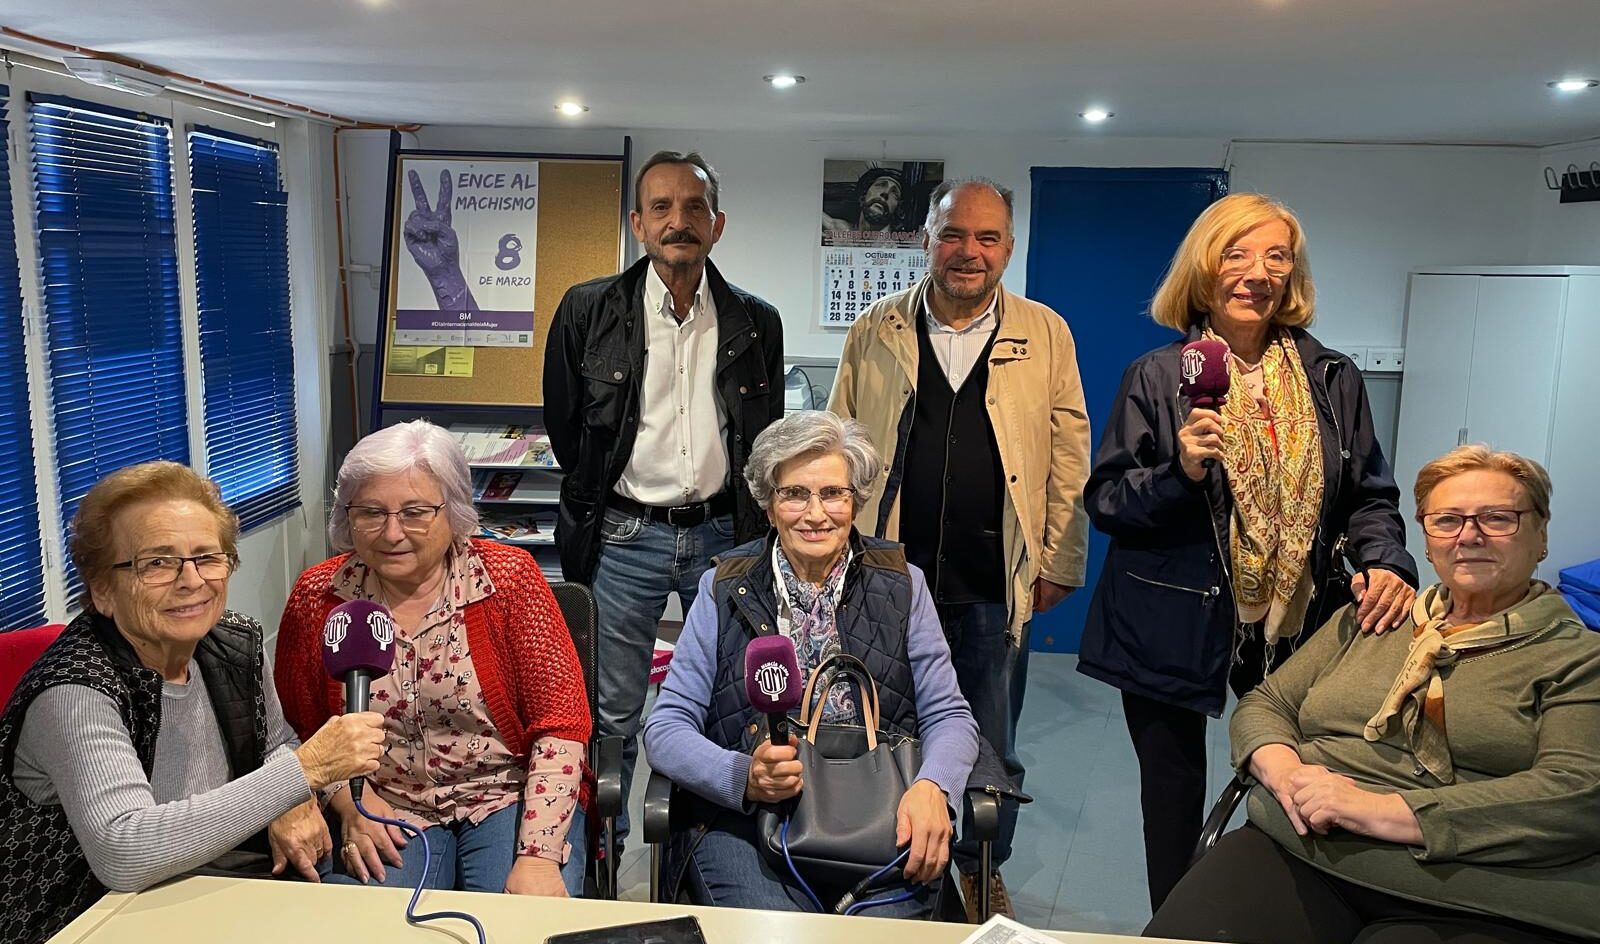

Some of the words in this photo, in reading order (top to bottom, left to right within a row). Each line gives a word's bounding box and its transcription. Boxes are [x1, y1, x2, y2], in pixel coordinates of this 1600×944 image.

[458, 173, 506, 188] ENCE
[510, 174, 536, 191] AL
[456, 196, 535, 211] MACHISMO
[494, 234, 522, 270] 8
[850, 270, 854, 278] 1
[864, 270, 870, 278] 2
[880, 271, 885, 279] 3
[894, 271, 900, 279] 4
[909, 272, 915, 280] 5
[480, 276, 492, 286] DE
[496, 276, 531, 287] MARZO
[834, 280, 839, 288] 7
[848, 280, 854, 289] 8
[864, 281, 870, 289] 9
[877, 282, 887, 290] 10
[893, 282, 901, 290] 11
[832, 291, 841, 300] 14
[847, 291, 856, 300] 15
[862, 292, 871, 300] 16
[830, 302, 840, 310] 21
[845, 302, 856, 311] 22
[830, 313, 841, 321] 28
[845, 313, 856, 321] 29
